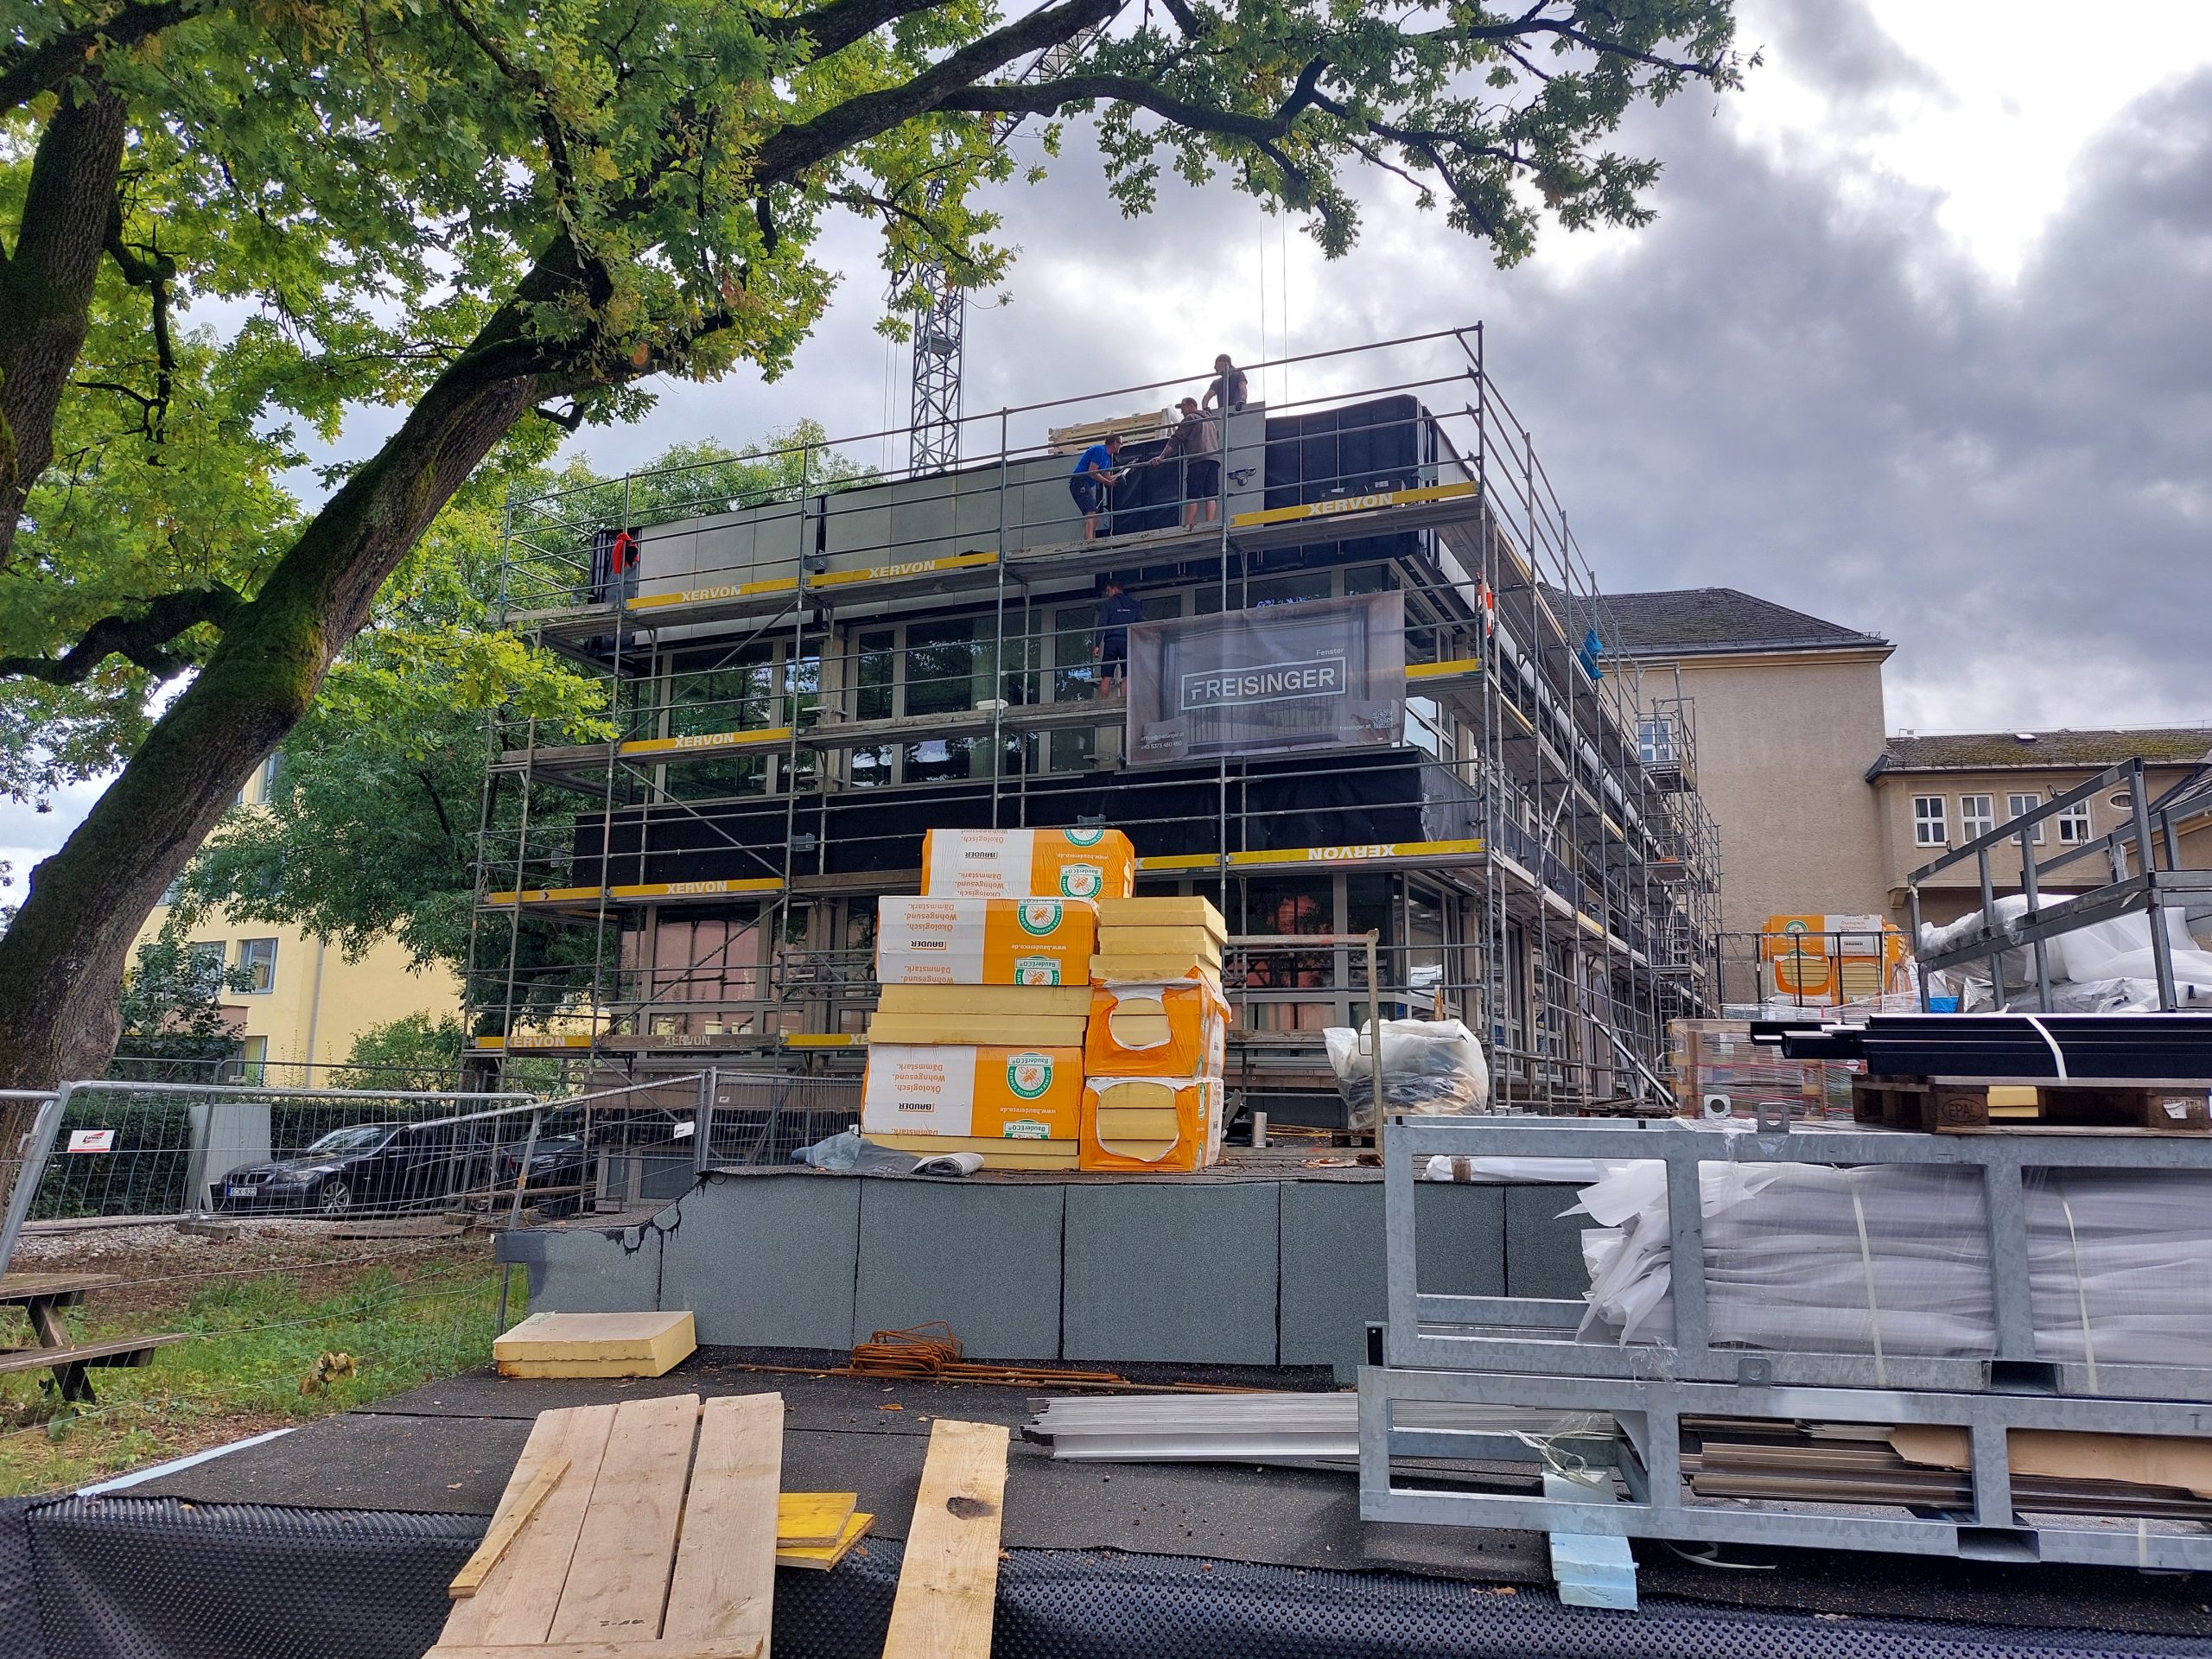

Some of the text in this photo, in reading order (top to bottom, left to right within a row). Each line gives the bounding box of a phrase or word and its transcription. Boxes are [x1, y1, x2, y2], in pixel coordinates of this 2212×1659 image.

[1308, 493, 1393, 516] XERVON
[868, 560, 936, 578] XERVON
[681, 584, 741, 602] XERVON
[1316, 647, 1344, 657] Fenster
[1191, 667, 1335, 701] FREISINGER
[675, 733, 734, 748] XERVON
[961, 835, 1004, 843] Ökologisch.
[1308, 844, 1396, 861] XERVON
[957, 872, 1001, 880] Dämmstark.
[667, 880, 728, 895] XERVON
[908, 903, 954, 912] Dämmstark.
[904, 912, 957, 921] Wohngesund.
[906, 924, 953, 933] Ökologisch.
[904, 965, 951, 974] Dämmstark.
[900, 976, 955, 985] Wohngesund.
[892, 1073, 946, 1082] Wohngesund.
[894, 1084, 942, 1094] Ökologisch.
